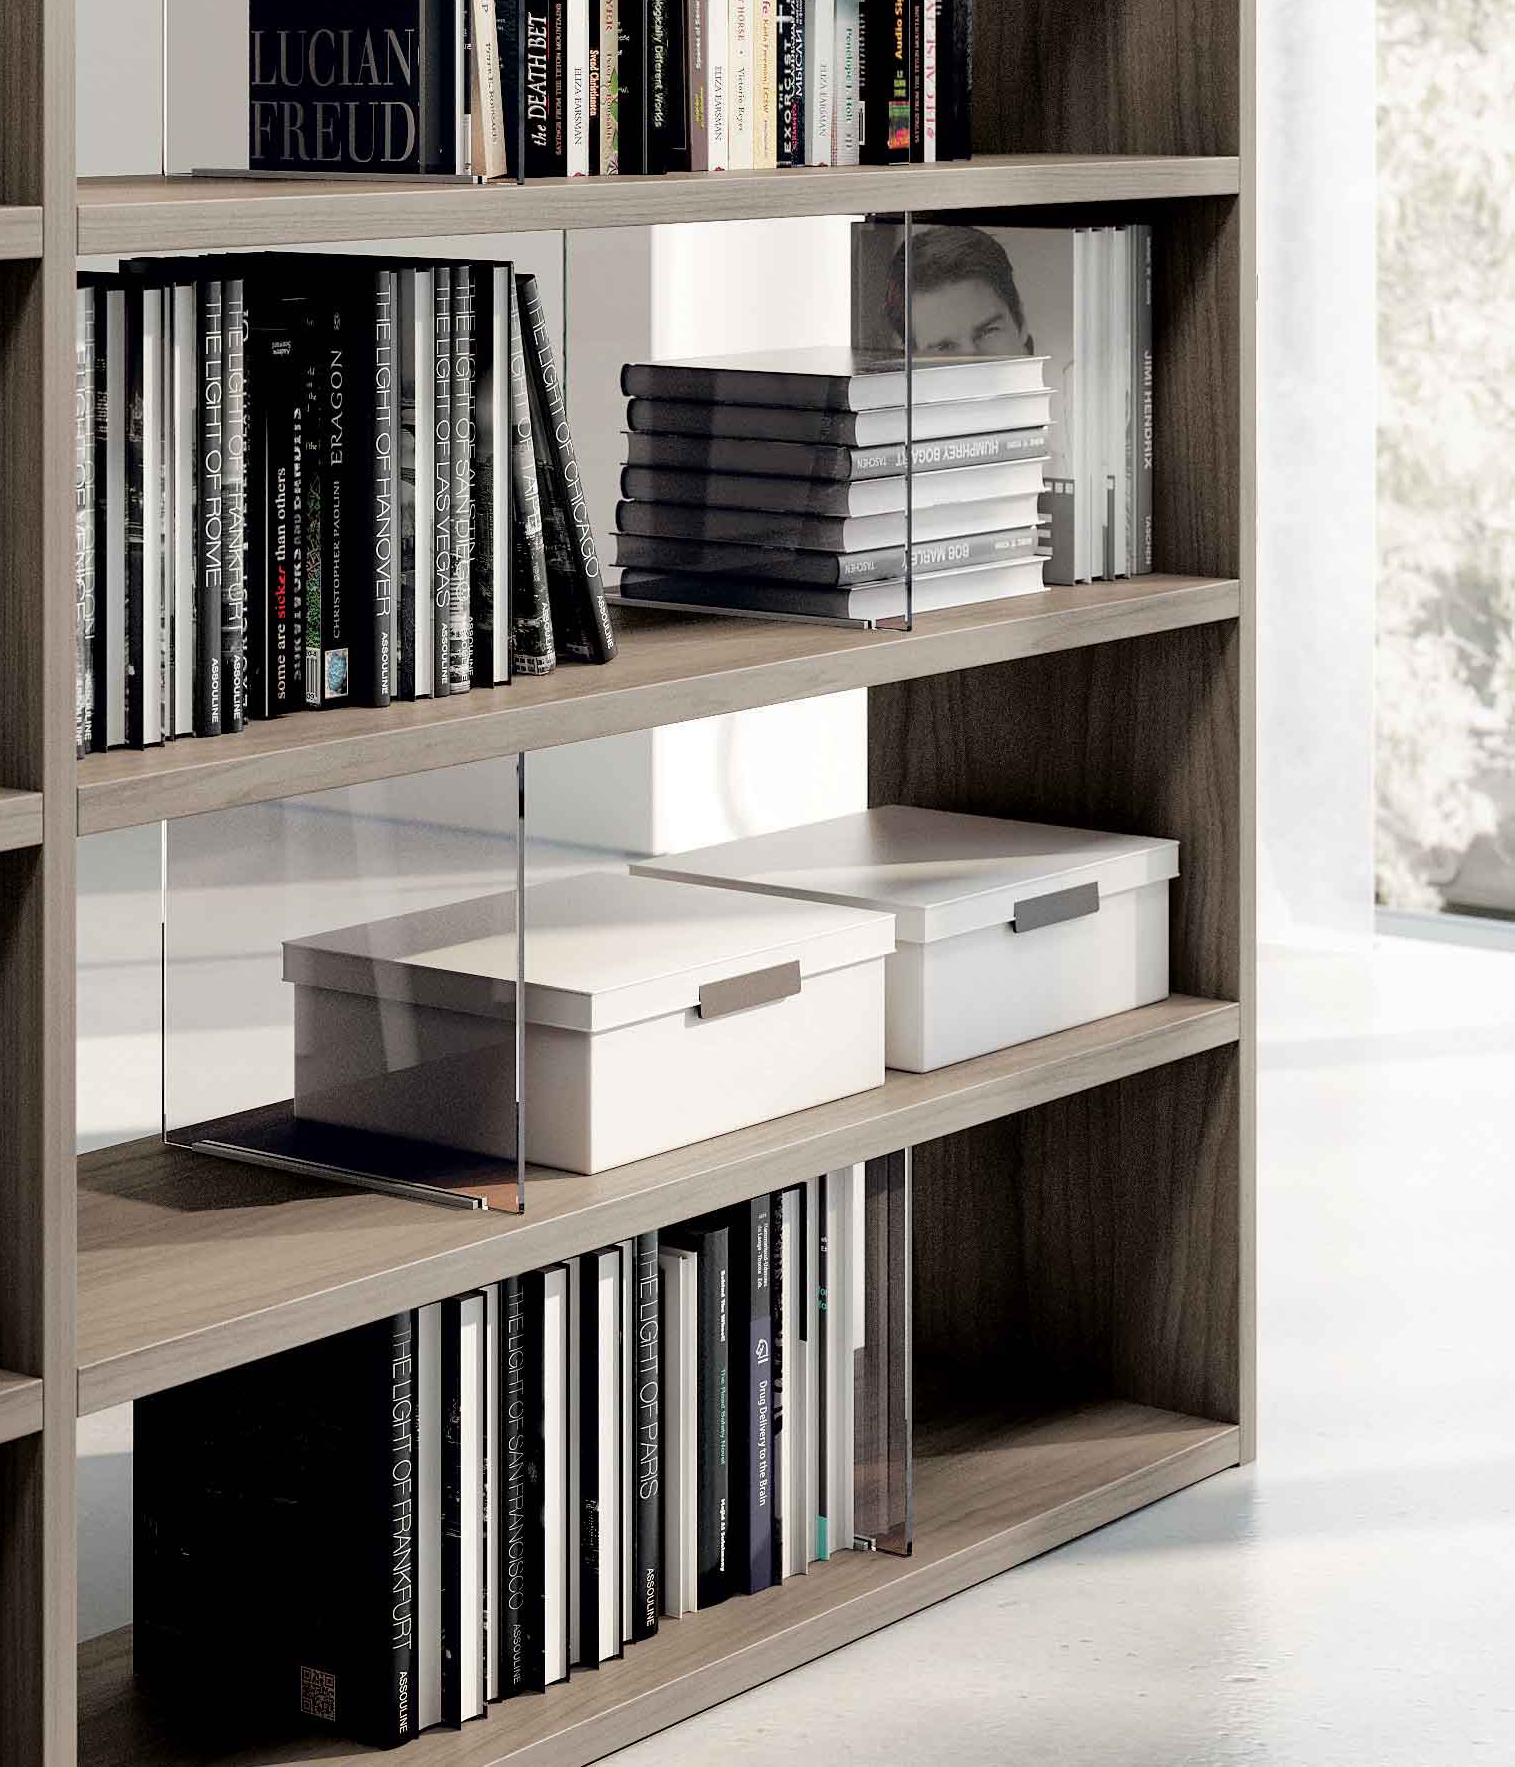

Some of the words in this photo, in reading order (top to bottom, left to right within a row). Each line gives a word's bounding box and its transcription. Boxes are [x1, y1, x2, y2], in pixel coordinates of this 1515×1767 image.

[250, 26, 416, 88] LUCIAN
[527, 11, 547, 49] BET
[893, 20, 904, 60] Audio
[527, 54, 547, 120] DEATH
[653, 45, 665, 90] Different
[784, 38, 793, 155] EXORCIST
[250, 100, 417, 163] FREUD
[530, 124, 547, 147] the
[653, 92, 665, 129] Worlds
[206, 292, 222, 356] THE
[376, 283, 391, 342] THE
[436, 282, 451, 333] THE
[527, 296, 547, 346] THE
[376, 346, 391, 428] LIGHT
[436, 338, 451, 414] LIGHT
[538, 344, 565, 416] LIGHT
[1143, 349, 1153, 387] JIMI
[206, 358, 222, 438] LIGHT
[330, 350, 343, 468] ERAGON
[376, 432, 391, 472] OF
[436, 419, 451, 457] OF
[555, 421, 573, 458] OF
[1143, 390, 1153, 470] HENDRIX
[206, 448, 222, 490] OF
[436, 461, 451, 511] LAS
[856, 456, 888, 470] TASCHEN
[275, 466, 286, 520] others
[332, 480, 341, 538] PAOLINI
[563, 459, 600, 578] CHICAGO
[206, 495, 222, 586] ROME
[275, 523, 286, 561] than
[376, 476, 391, 616] HANOVER
[436, 514, 451, 608] VEGAS
[274, 564, 286, 620] sicker
[332, 542, 341, 640] CHRISTOPHER
[276, 623, 286, 650] are
[597, 594, 615, 650] ASSOULINE
[211, 655, 219, 722] ASSOULINE
[276, 654, 286, 699] some
[381, 631, 389, 695] ASSOULINE
[639, 1240, 659, 1299] THE
[508, 1285, 524, 1333] THE
[639, 1299, 659, 1375] LIGHT
[392, 1321, 412, 1379] THE
[508, 1333, 524, 1395] LIGHT
[392, 1379, 412, 1453] LIGHT
[508, 1399, 524, 1430] OF
[639, 1381, 659, 1419] OF
[756, 1379, 768, 1406] Drug
[756, 1406, 768, 1448] Delivery
[757, 1448, 768, 1459] to
[392, 1459, 412, 1495] OF
[508, 1433, 524, 1482] SAN
[639, 1421, 659, 1501] PARIS
[757, 1460, 768, 1477] the
[757, 1478, 768, 1507] Brain
[392, 1498, 412, 1651] FRANKFURT
[508, 1482, 524, 1610] FRANCISCO
[645, 1568, 656, 1627] ASSOULINE
[513, 1623, 522, 1685] ASSOULINE
[399, 1670, 408, 1734] ASSOULINE
